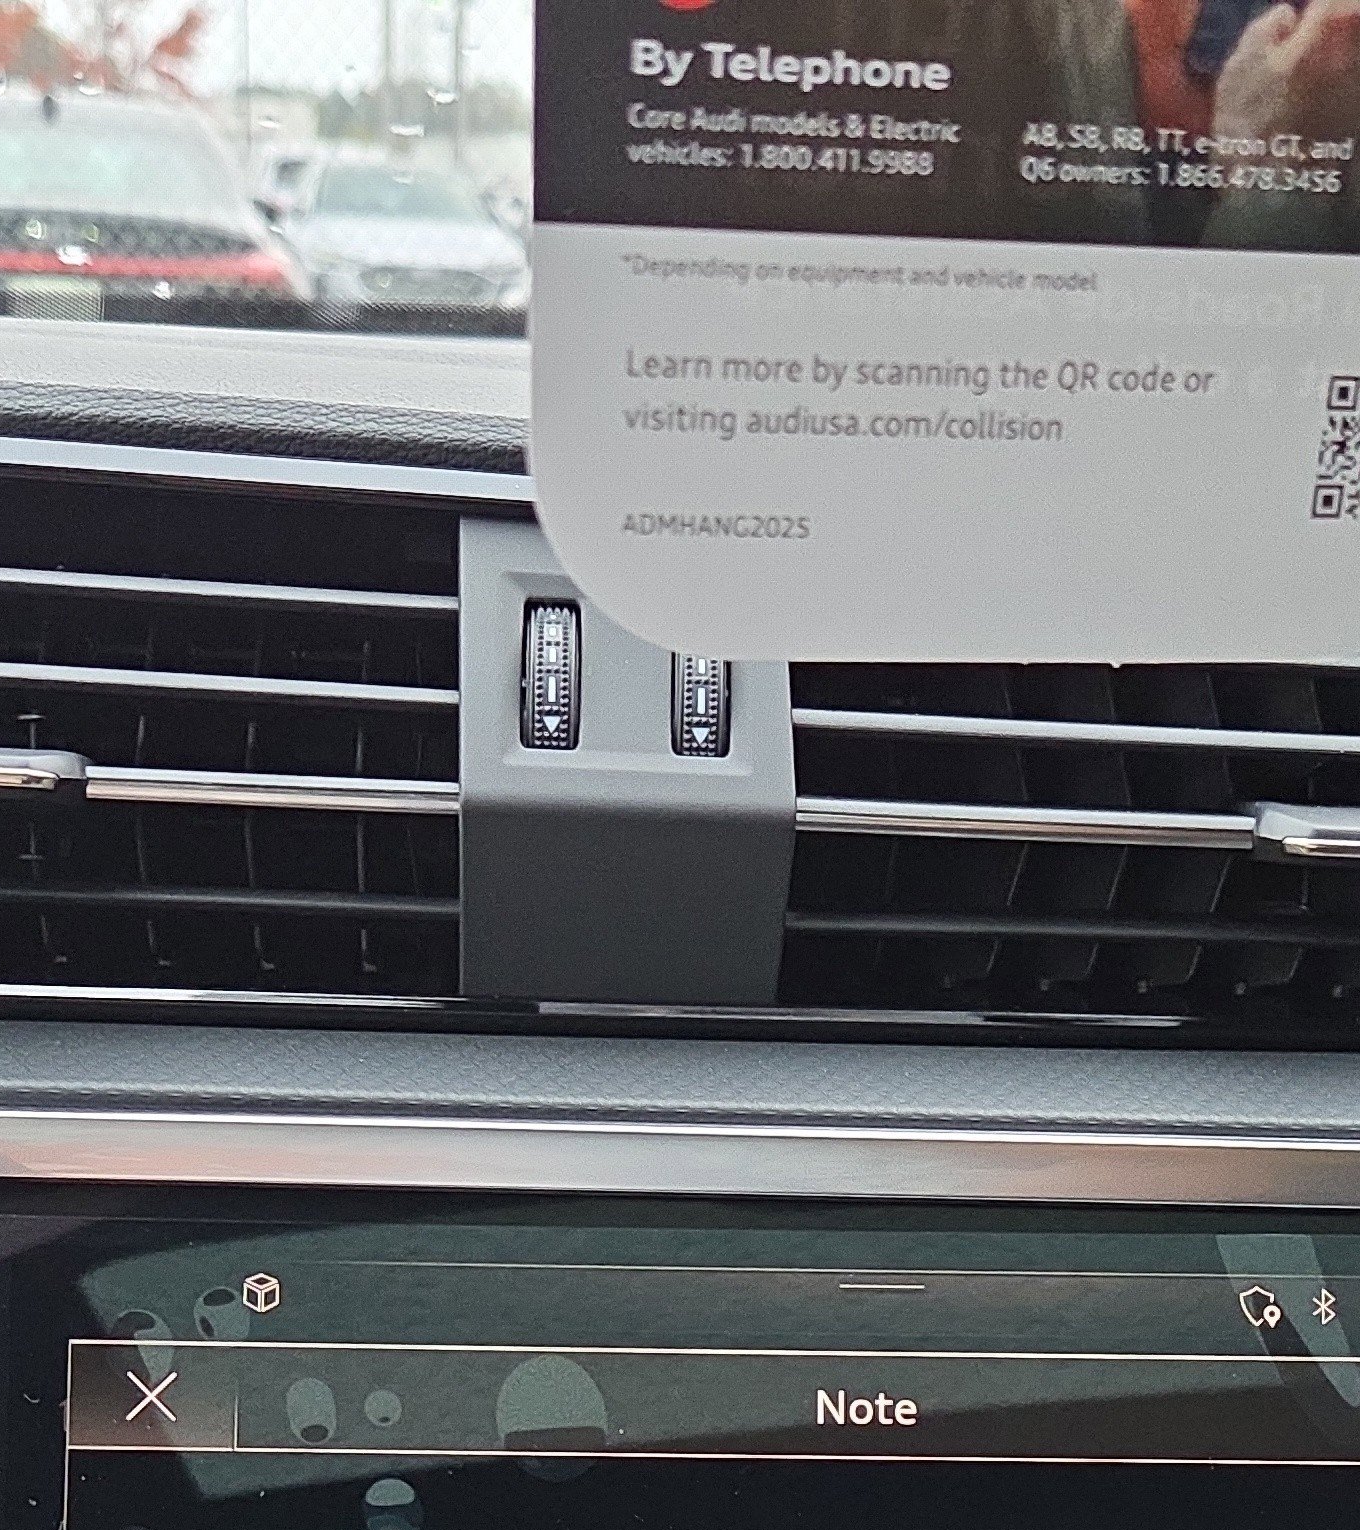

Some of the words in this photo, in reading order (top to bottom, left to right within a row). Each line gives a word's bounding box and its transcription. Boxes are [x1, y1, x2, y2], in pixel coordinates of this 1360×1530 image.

[630, 39, 693, 86] By
[701, 42, 951, 92] Telephone
[627, 102, 687, 130] Core
[689, 105, 746, 132] Audi
[750, 112, 840, 137] models
[844, 113, 863, 138] &
[870, 114, 962, 142] Electric
[626, 140, 733, 167] vehicles:
[740, 143, 934, 175] 1.800.411.9988
[1023, 122, 1064, 150] A8,
[1067, 123, 1108, 153] S8,
[1112, 126, 1151, 154] R8,
[1156, 127, 1190, 155] TT,
[1194, 133, 1266, 157] e-tron
[1270, 135, 1306, 161] GT,
[1310, 137, 1354, 160] and
[1058, 163, 1150, 185] owners:
[1156, 162, 1342, 193] 1.866.478.3456
[755, 263, 784, 281] on
[787, 264, 904, 289] equipment
[909, 267, 949, 287] and
[953, 268, 1027, 290] vehicle
[1031, 271, 1097, 292] model
[625, 349, 712, 379] Learn
[721, 357, 803, 383] more
[812, 353, 848, 392] by
[857, 359, 989, 396] scanning
[1000, 360, 1049, 391] the
[1057, 361, 1099, 395] QR
[1107, 363, 1177, 393] code
[1183, 371, 1215, 394] or
[622, 403, 737, 442] visiting
[746, 404, 1064, 442] audiusa.com/collision
[623, 513, 810, 539] ADMHANG2025
[816, 1389, 918, 1426] Note
